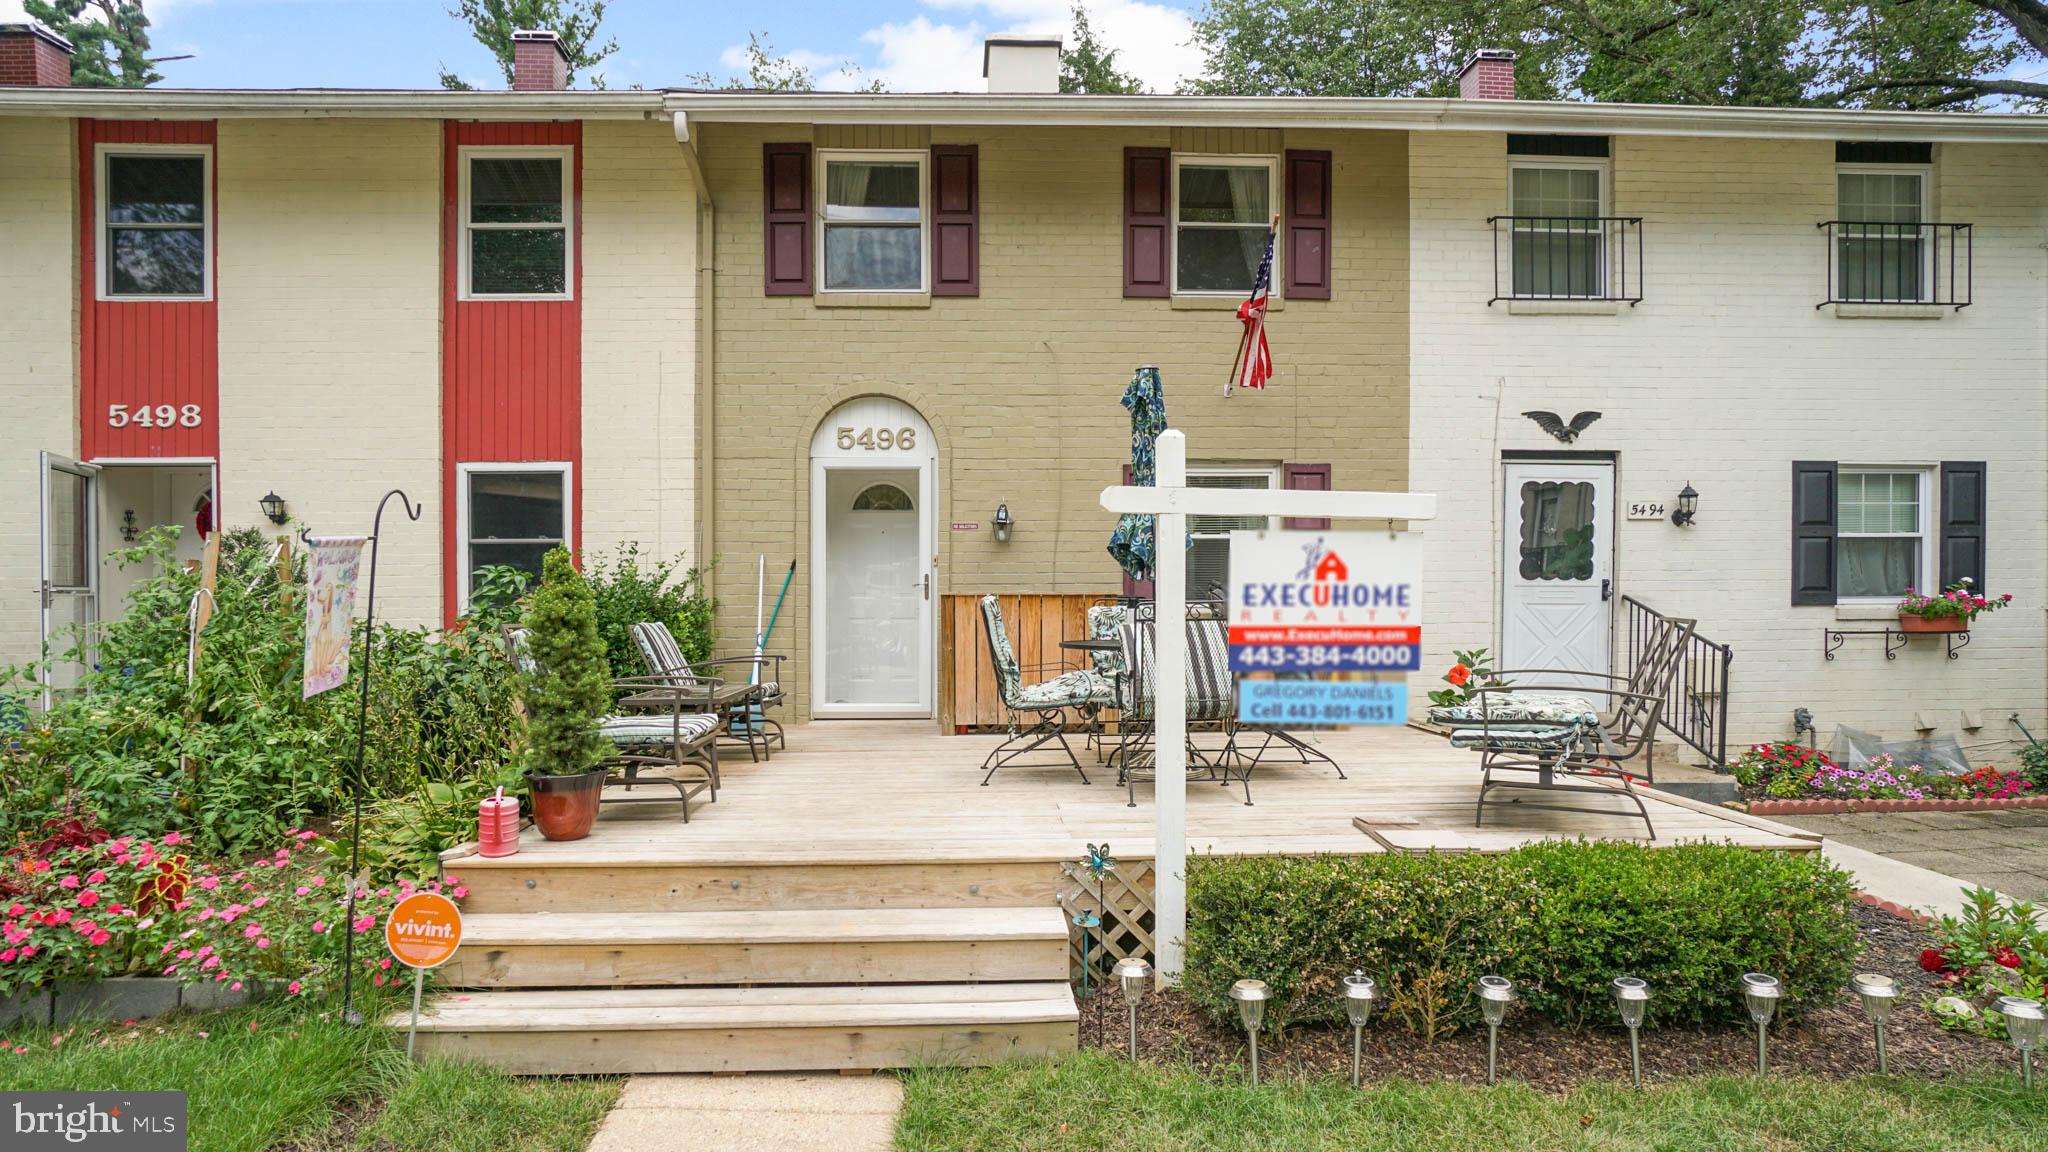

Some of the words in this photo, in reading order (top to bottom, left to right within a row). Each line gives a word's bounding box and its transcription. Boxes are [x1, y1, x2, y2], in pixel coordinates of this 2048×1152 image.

[108, 404, 202, 428] 5498
[837, 427, 916, 450] 5496
[1243, 584, 1411, 607] EXECUHOME
[1244, 628, 1408, 642] www.ExecuHome.com
[1238, 646, 1412, 666] 443-384-4000
[1253, 684, 1325, 699] GREGORY
[1330, 687, 1394, 702] DANIELS
[1250, 703, 1283, 719] Cell
[1287, 704, 1394, 720] 443-801-6151
[395, 918, 455, 938] vivint.
